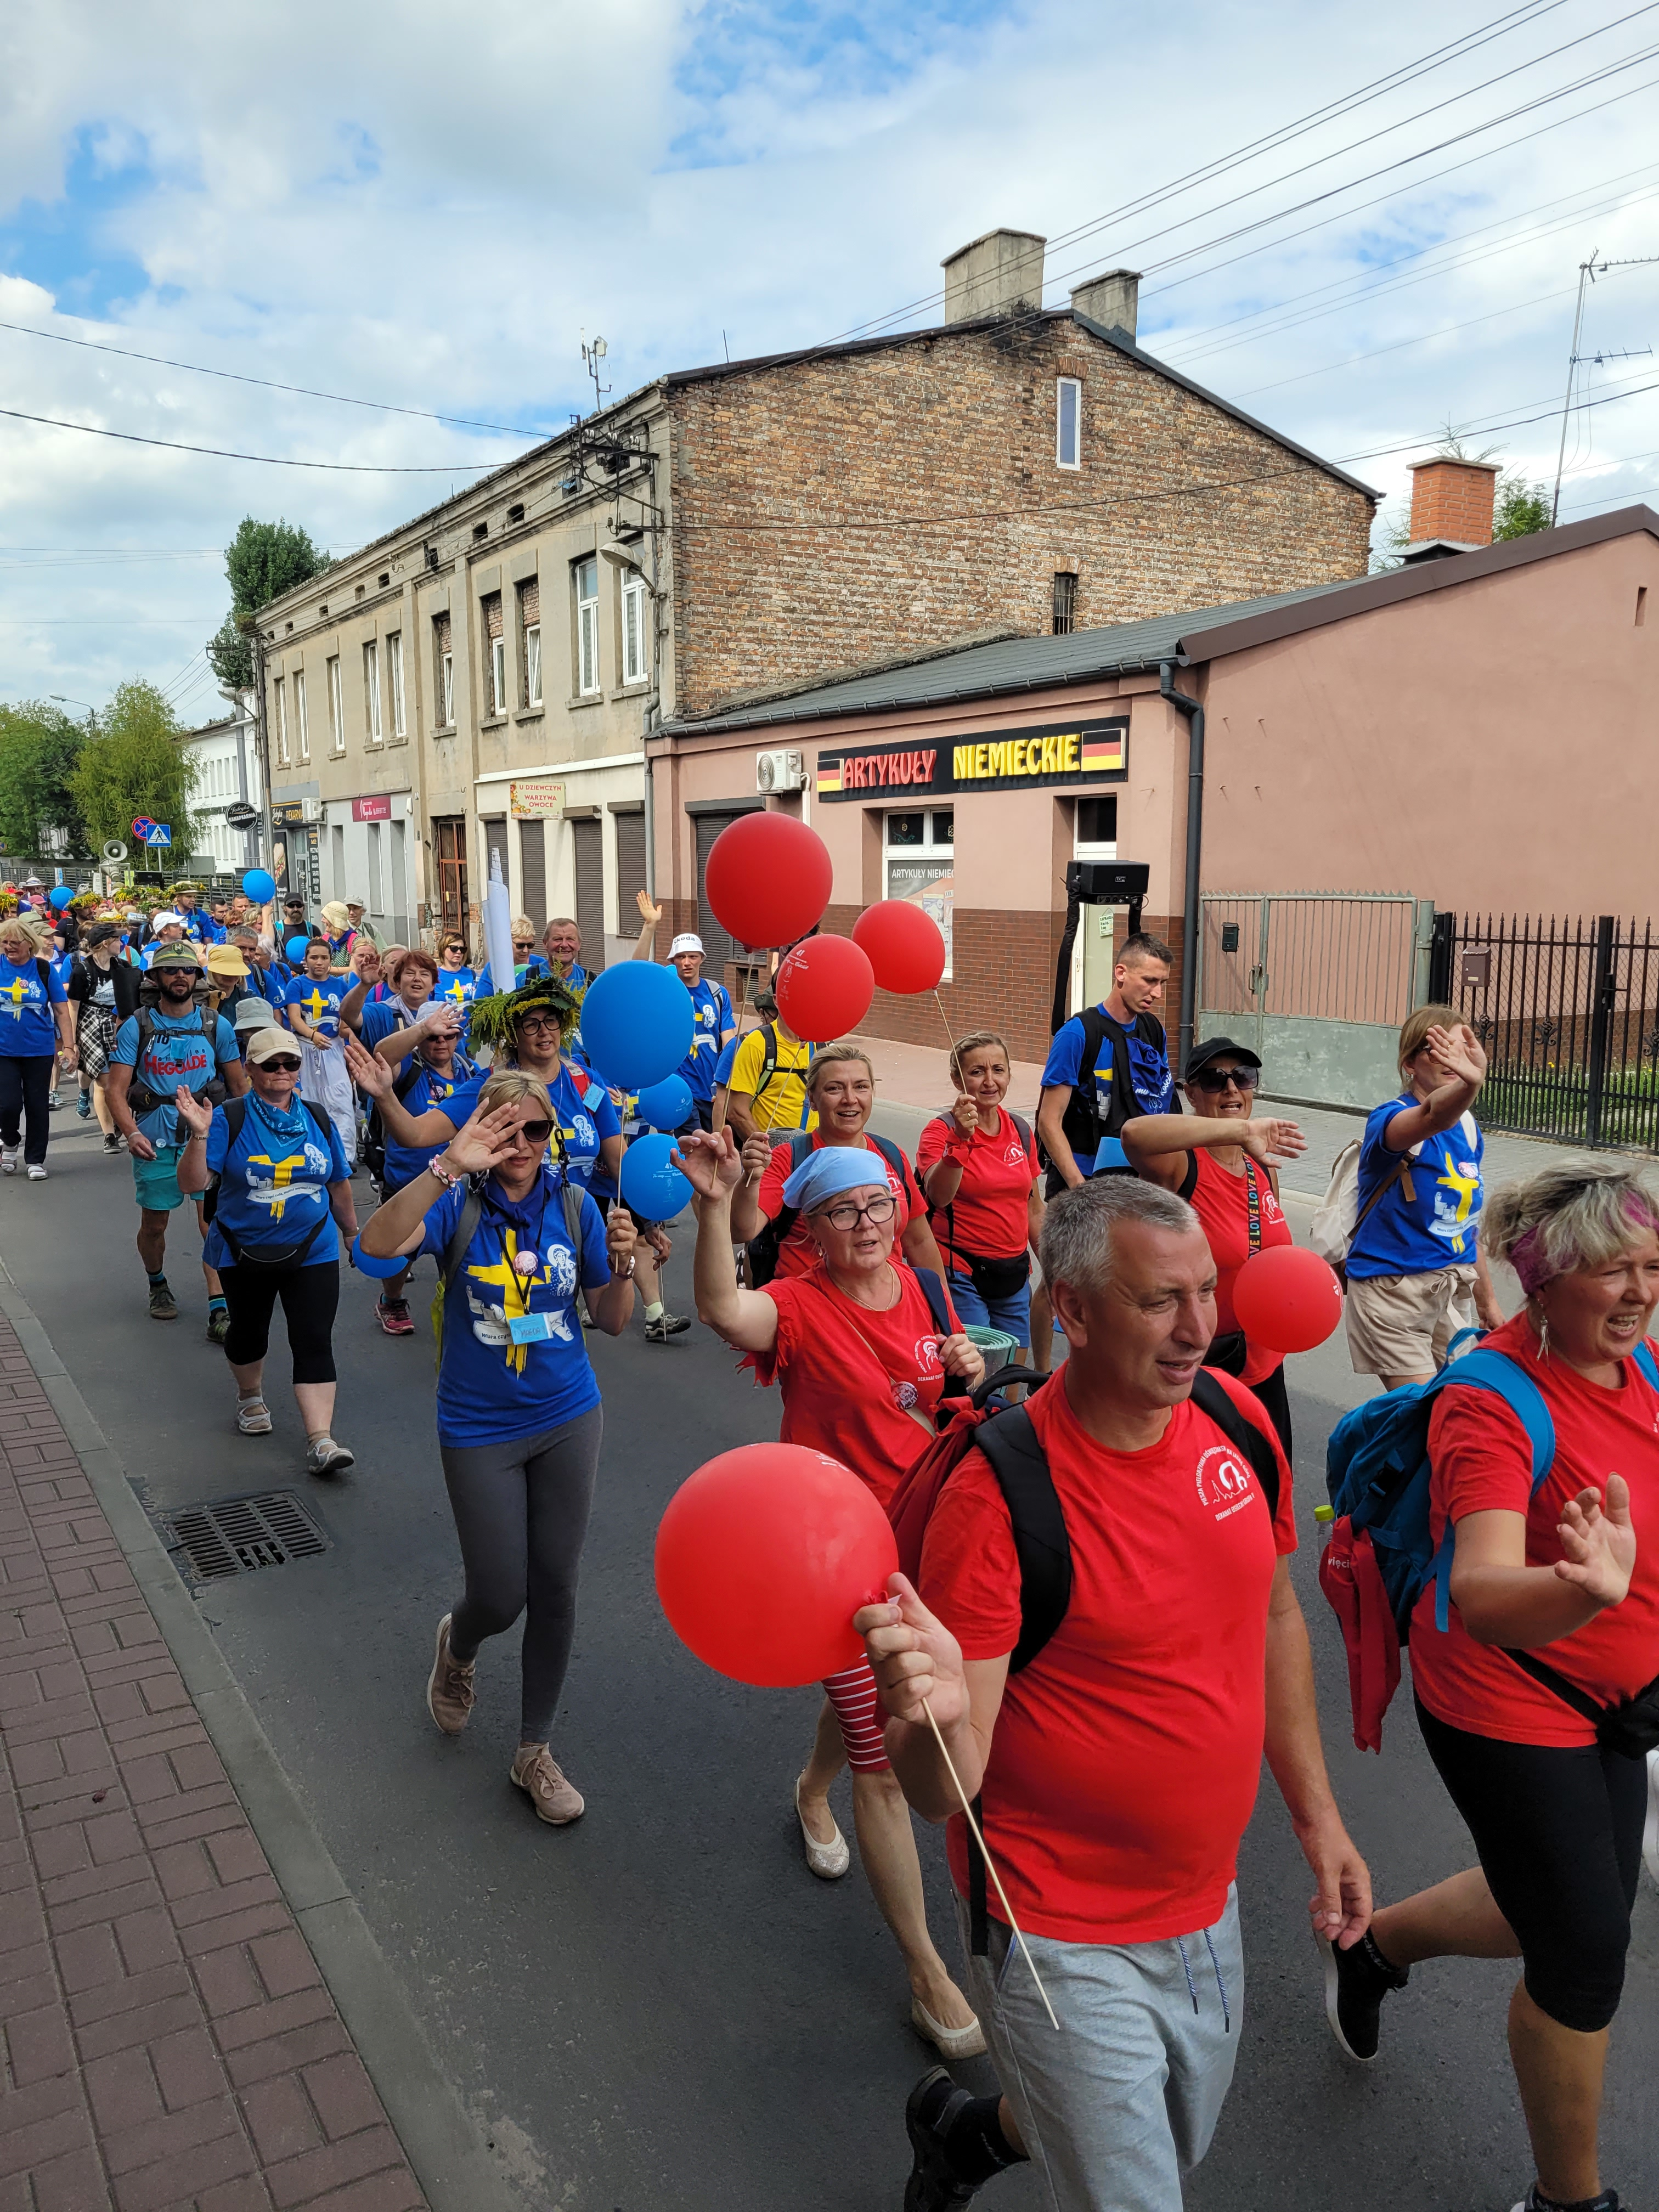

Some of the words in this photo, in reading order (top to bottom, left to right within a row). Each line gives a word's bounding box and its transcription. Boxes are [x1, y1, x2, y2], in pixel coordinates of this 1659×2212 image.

[844, 749, 936, 788] ARTYKUŁY
[953, 734, 1081, 780] NIEMIECKIE
[891, 868, 926, 878] ARTYKUŁY
[1248, 1178, 1259, 1206] LOVE
[1249, 1208, 1260, 1235] LOVE
[1197, 1488, 1209, 1506] PIESZA
[1215, 1508, 1232, 1521] DEKANAT
